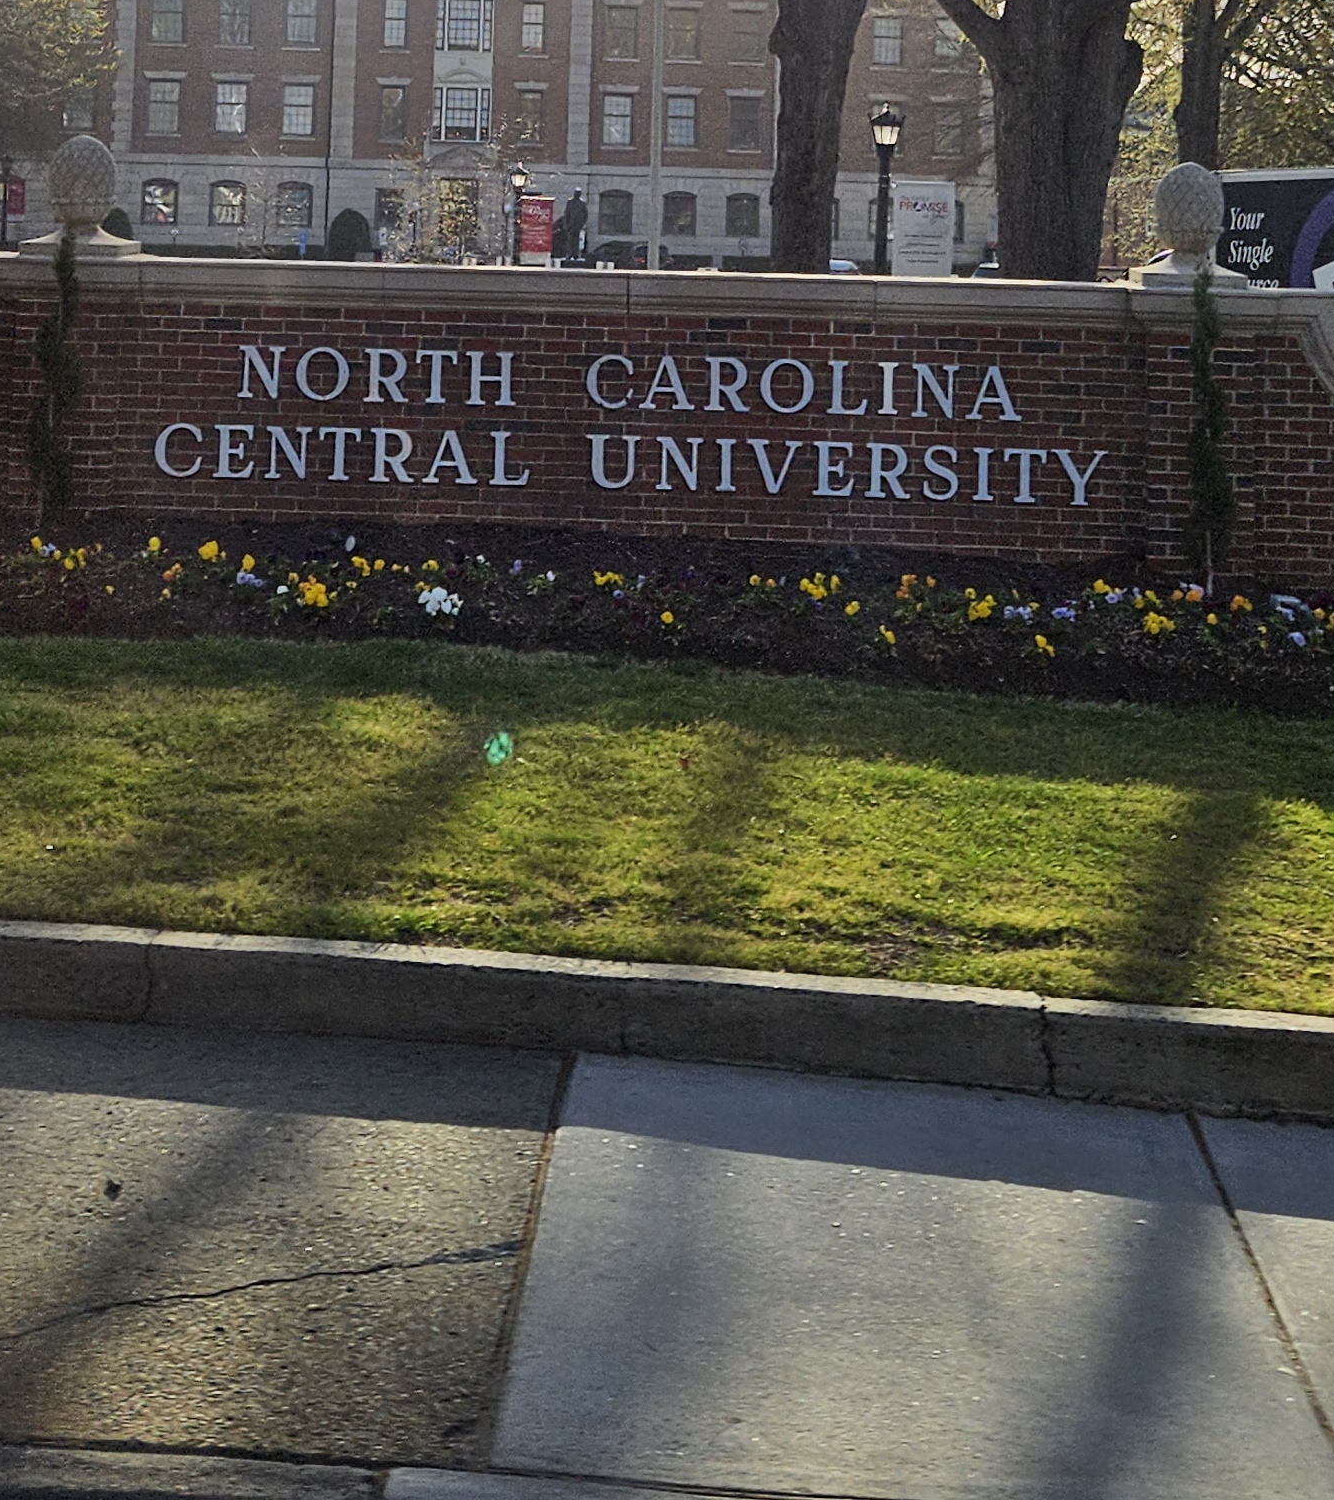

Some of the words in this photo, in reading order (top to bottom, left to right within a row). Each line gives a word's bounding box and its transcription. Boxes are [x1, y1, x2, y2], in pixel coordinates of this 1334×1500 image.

[1229, 207, 1265, 231] Your
[1227, 237, 1274, 271] Single
[236, 344, 517, 407] NORTH
[585, 354, 1023, 422] CAROLINA
[153, 422, 530, 487] CENTRAL
[585, 433, 1109, 506] UNIVERSITY
